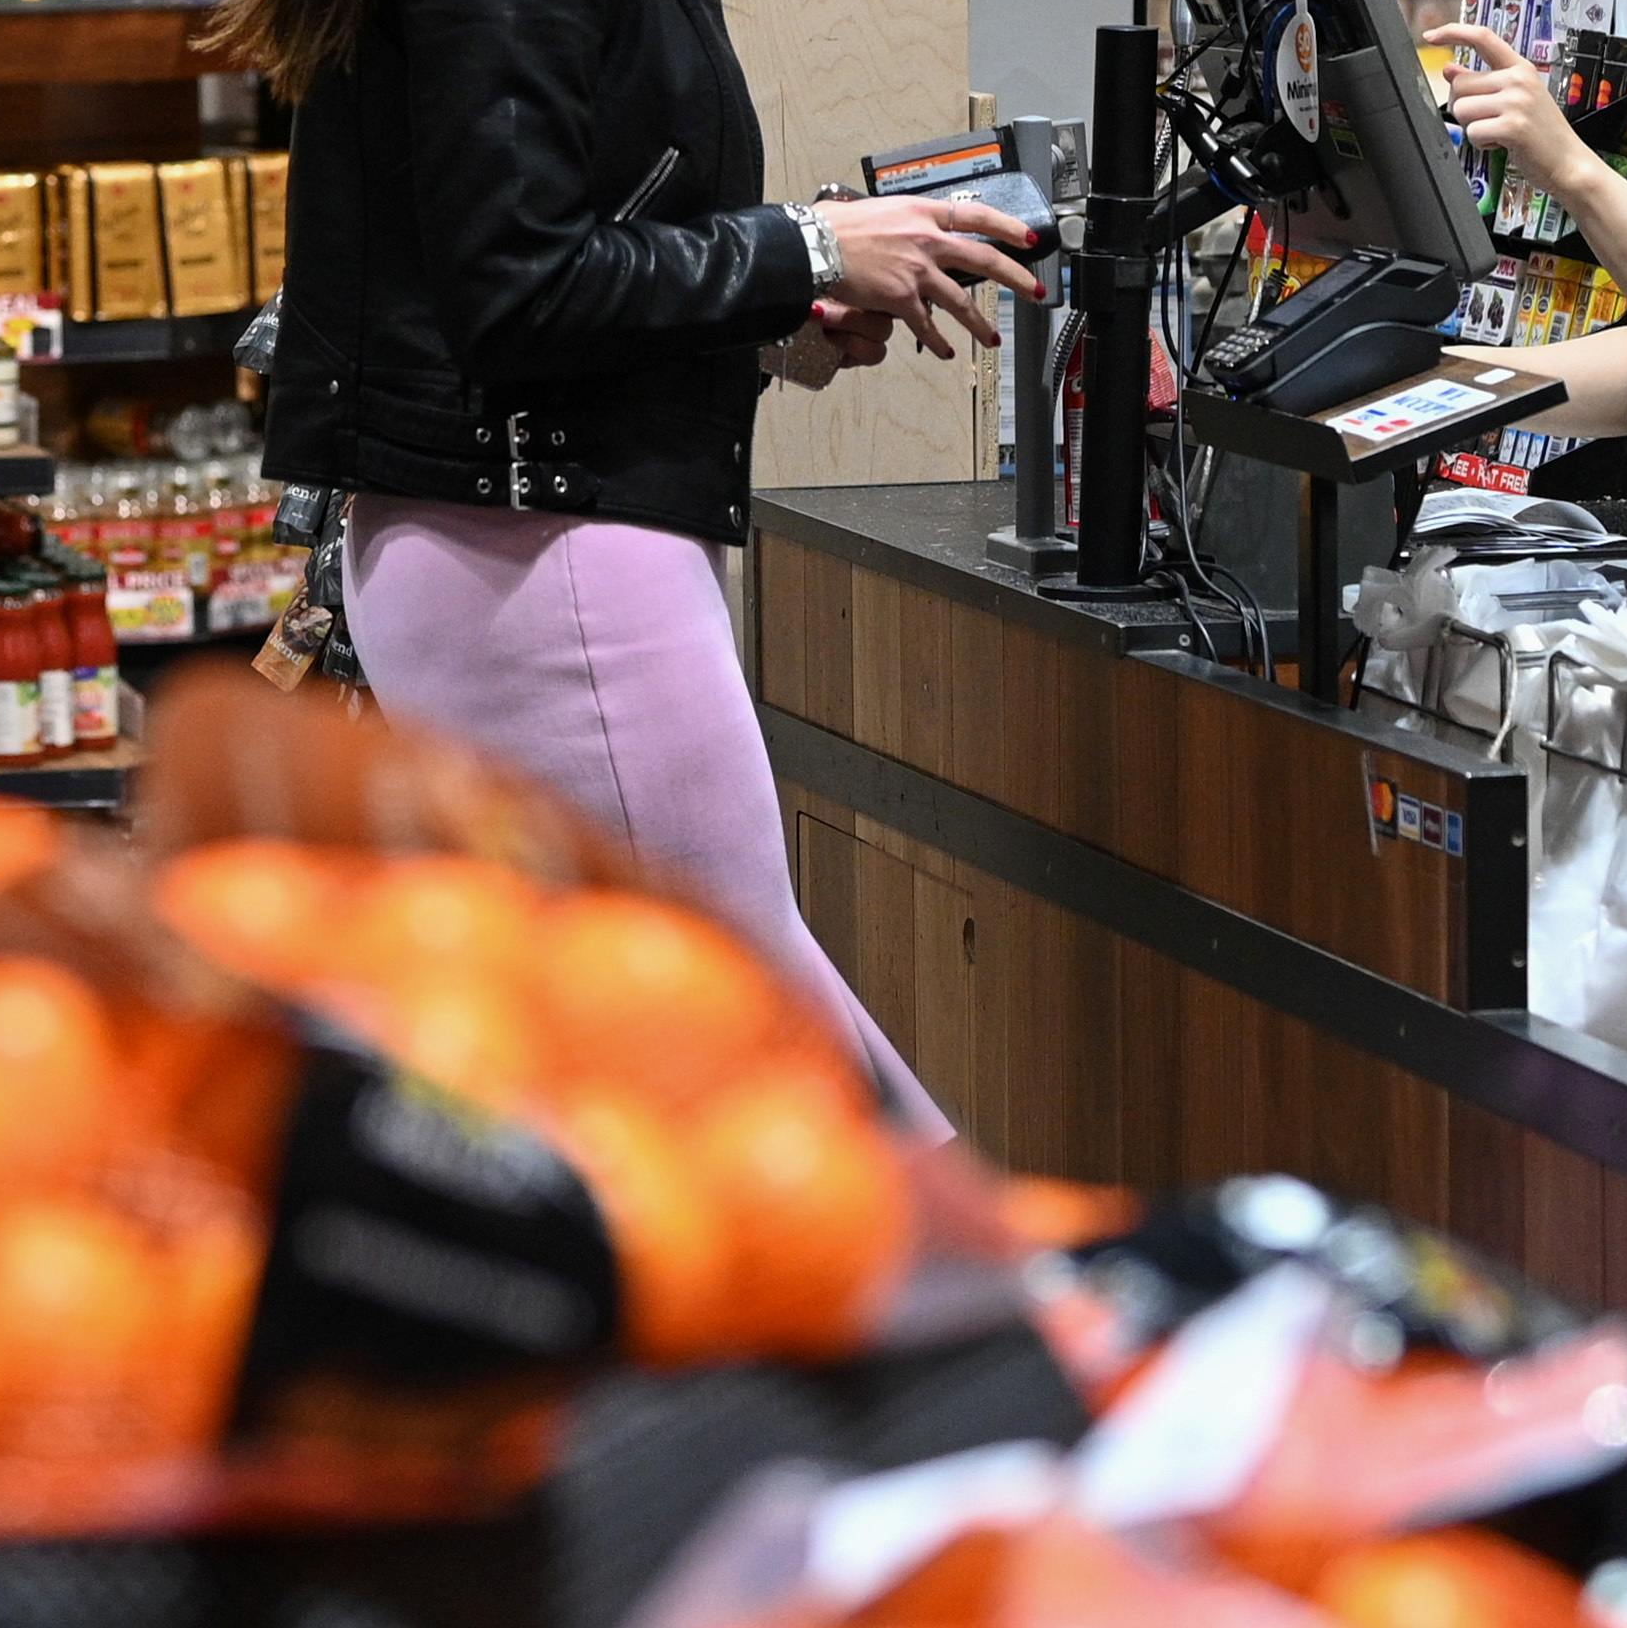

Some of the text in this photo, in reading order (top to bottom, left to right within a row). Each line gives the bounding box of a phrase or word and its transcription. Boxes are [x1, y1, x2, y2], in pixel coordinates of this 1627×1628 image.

[1533, 43, 1550, 61] JOLS
[1496, 258, 1517, 277] JOLS
[1392, 394, 1457, 416] ACCEPT
[285, 482, 321, 503] lend
